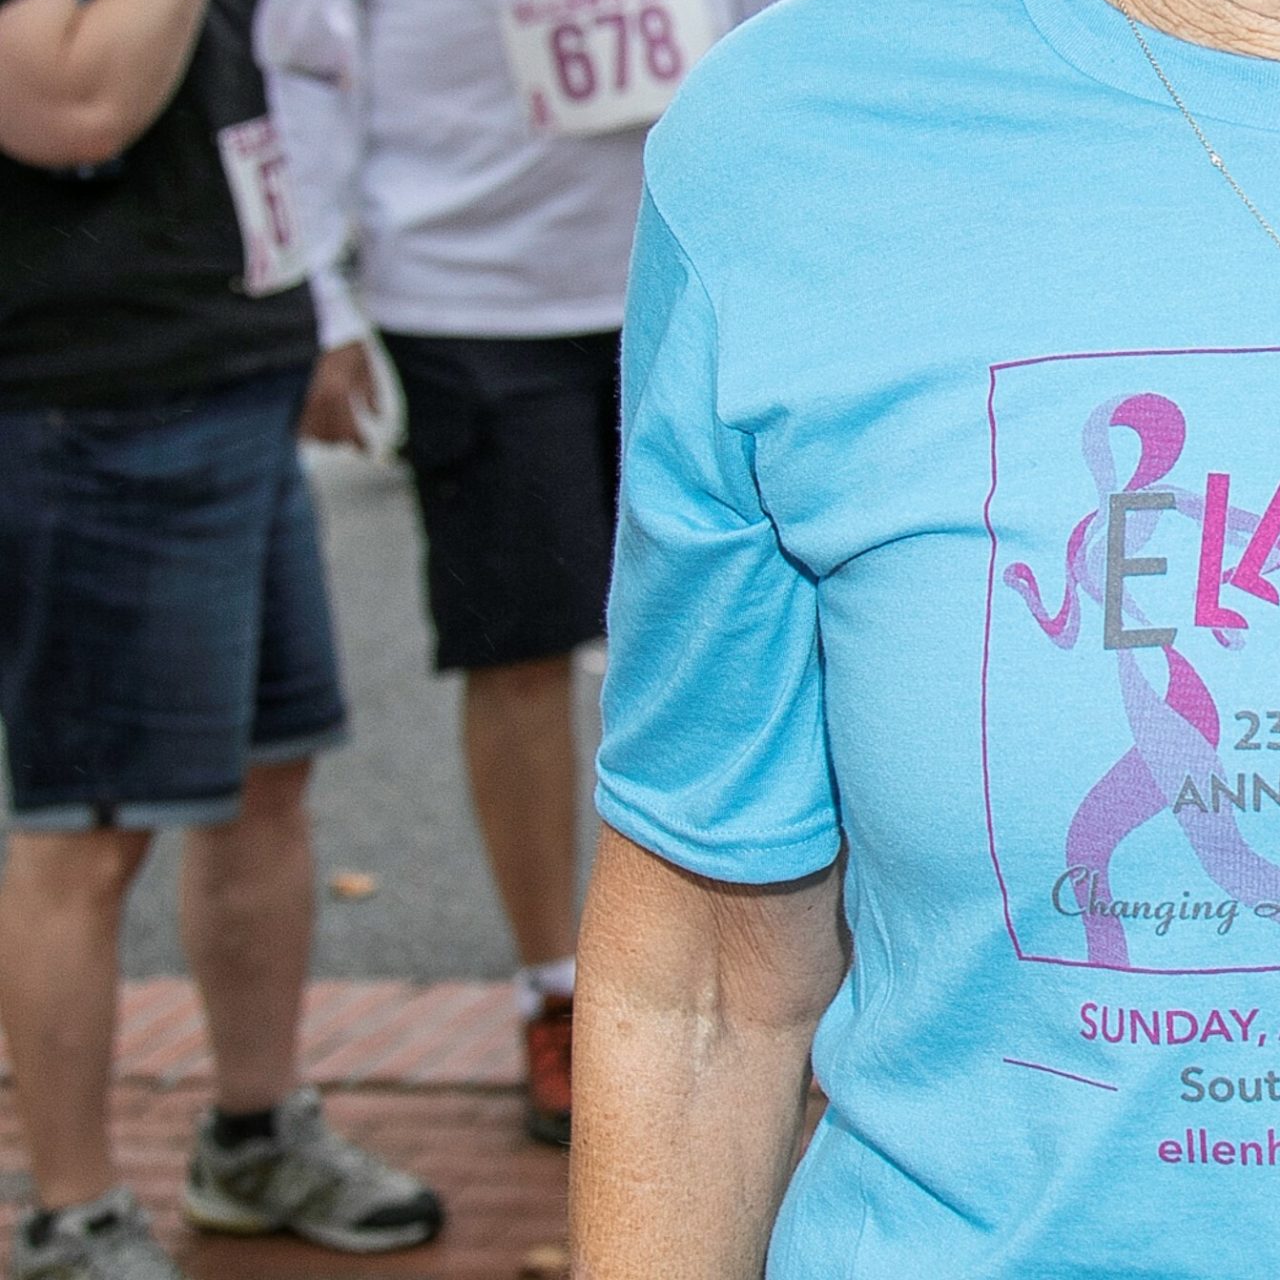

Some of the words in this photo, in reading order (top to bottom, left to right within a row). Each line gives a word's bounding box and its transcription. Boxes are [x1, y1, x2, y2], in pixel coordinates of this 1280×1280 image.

[552, 6, 684, 102] 678
[1052, 865, 1239, 936] Changing
[1079, 1004, 1268, 1049] SUNDAY,
